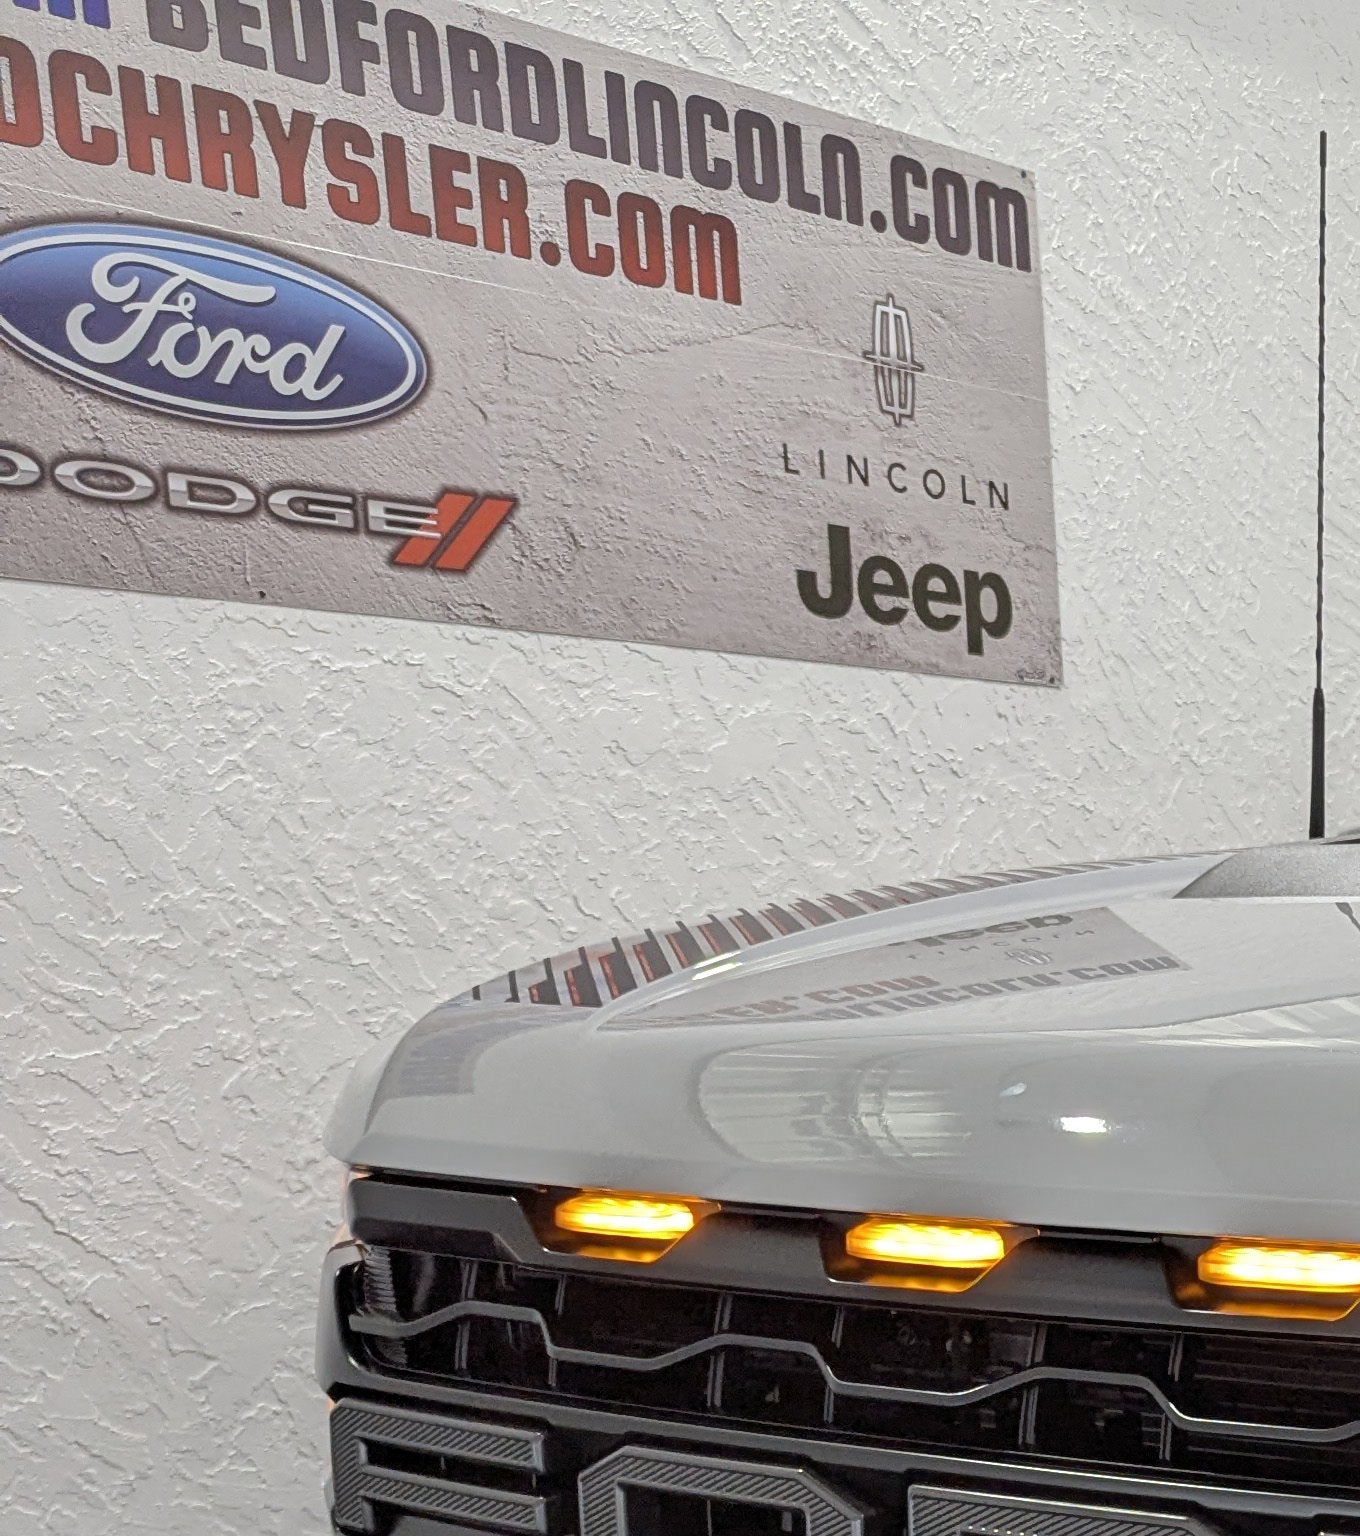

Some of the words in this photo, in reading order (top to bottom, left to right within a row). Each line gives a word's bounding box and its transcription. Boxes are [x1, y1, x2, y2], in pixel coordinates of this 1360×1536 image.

[65, 252, 346, 401] Ford
[782, 442, 1010, 511] LINCOLN
[796, 523, 1013, 656] Jeep
